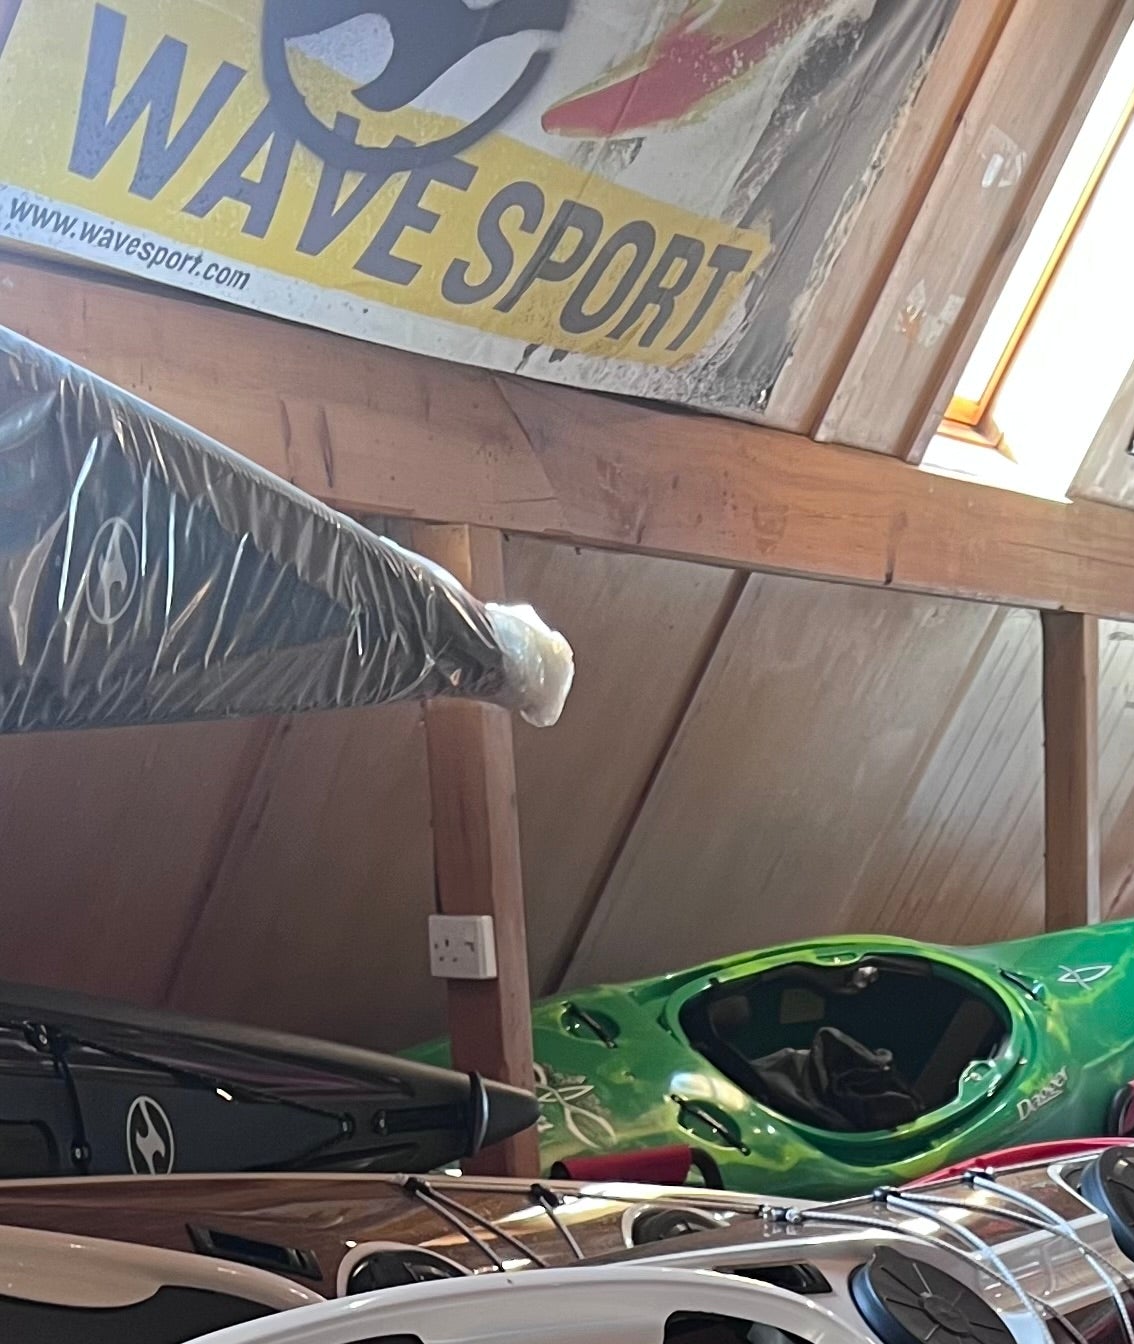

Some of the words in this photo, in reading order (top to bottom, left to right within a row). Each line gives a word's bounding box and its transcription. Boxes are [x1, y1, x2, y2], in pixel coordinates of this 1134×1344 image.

[8, 196, 252, 292] www.wavesport.com
[67, 4, 478, 285] WAVE
[440, 180, 753, 351] SPORT
